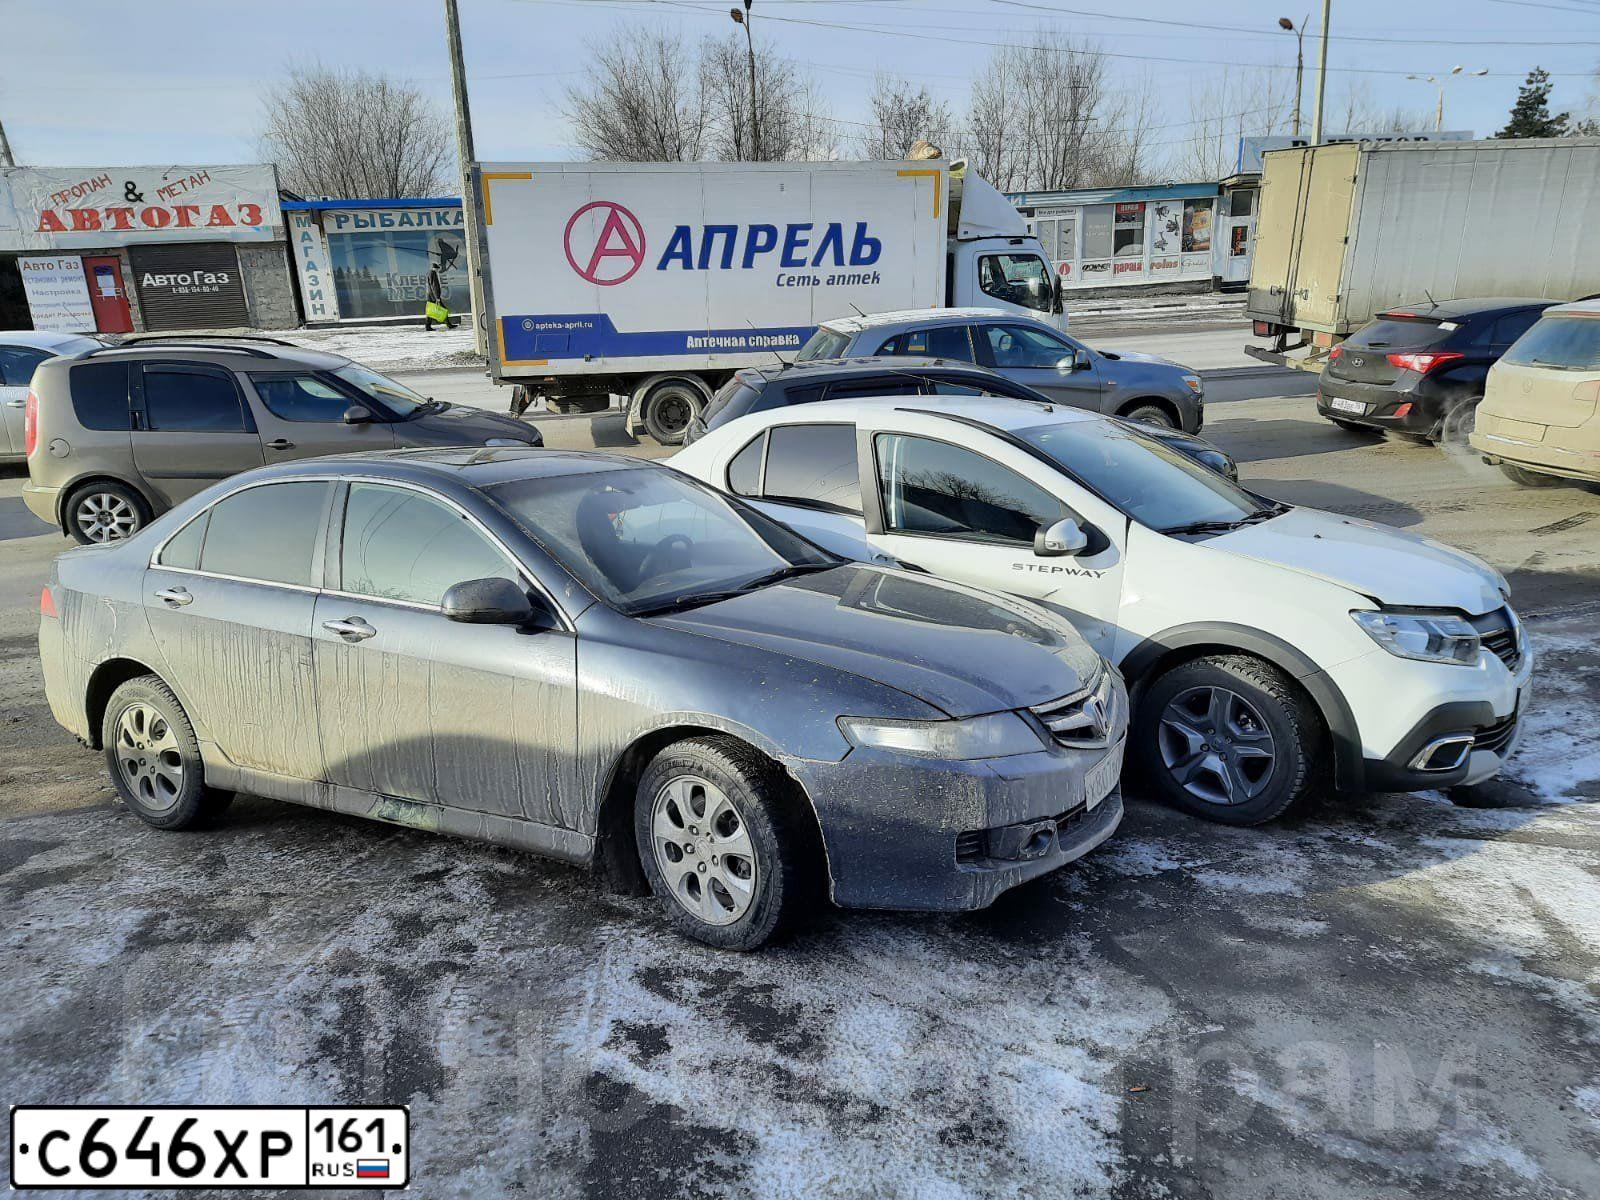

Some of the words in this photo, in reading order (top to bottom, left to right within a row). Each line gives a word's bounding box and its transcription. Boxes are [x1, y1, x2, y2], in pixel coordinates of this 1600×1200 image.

[51, 173, 113, 206] ПРОПАН
[124, 181, 144, 203] &
[156, 170, 212, 201] МЕТАН
[34, 203, 263, 233] АВТОГАЗ
[334, 210, 464, 229] РЫБАЛКА
[657, 221, 882, 271] АПРЕЛЬ
[23, 261, 54, 271] Авто
[57, 260, 80, 270] Газ
[295, 216, 326, 315] МАГАЗИН
[776, 272, 821, 288] Сеть
[826, 270, 881, 286] аптек
[535, 321, 593, 330] apteka-april.ru
[686, 333, 746, 349] Аптечная
[748, 333, 800, 350] справка
[1011, 563, 1106, 579] STEPWAY
